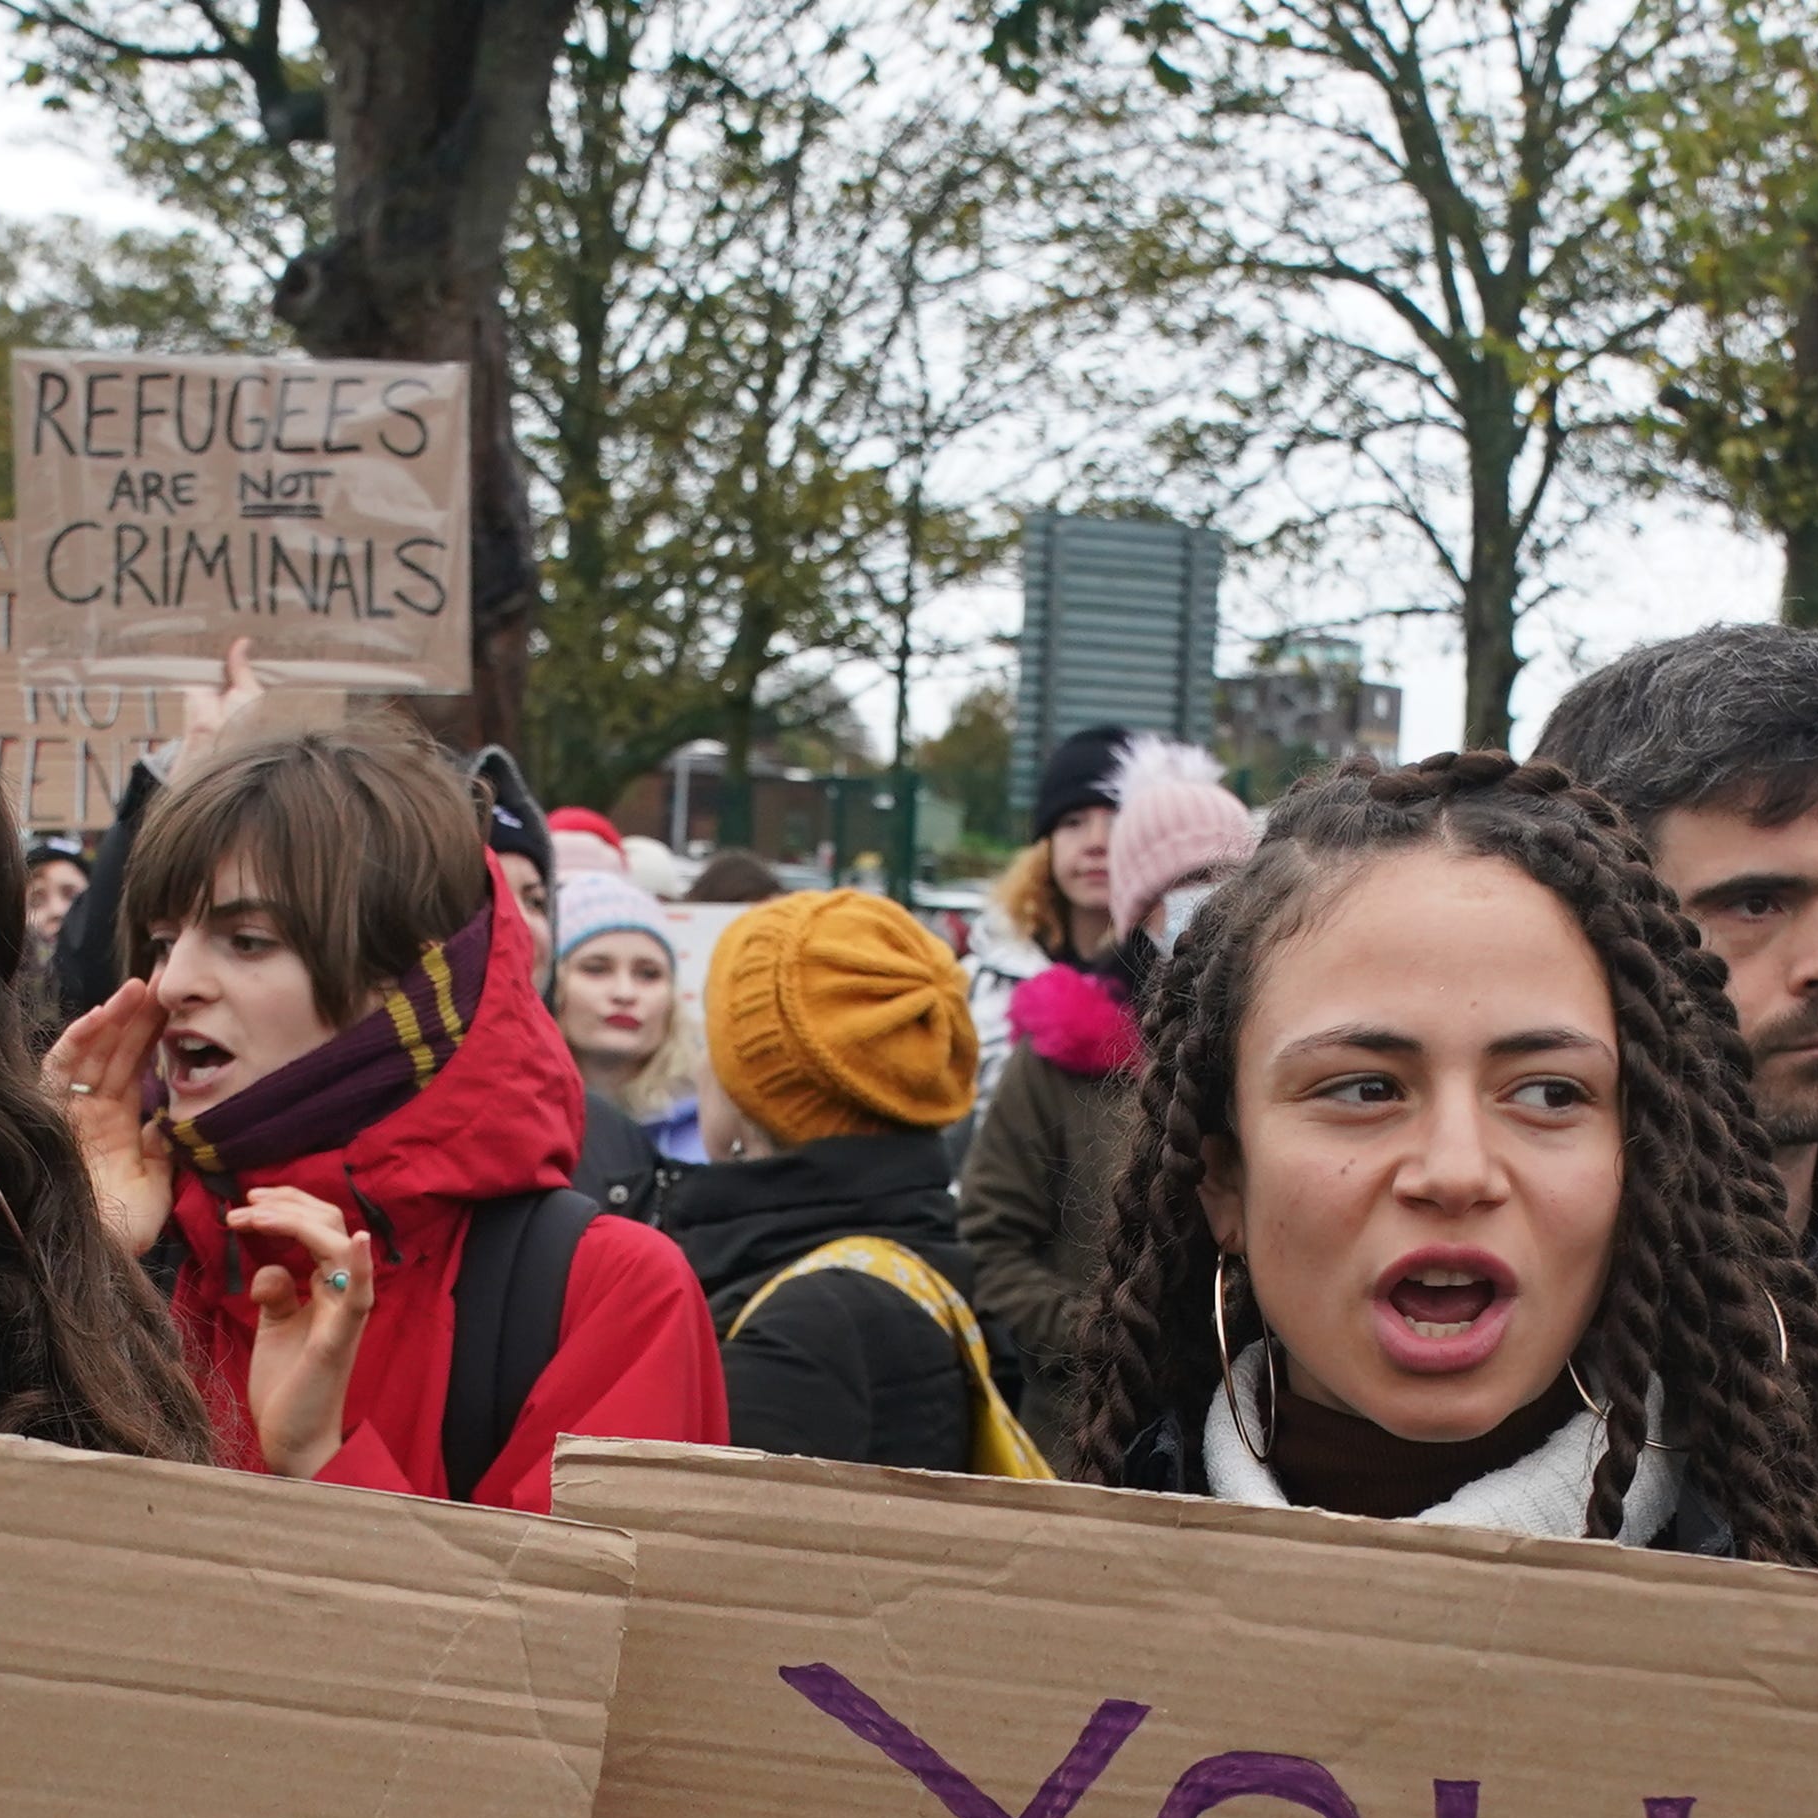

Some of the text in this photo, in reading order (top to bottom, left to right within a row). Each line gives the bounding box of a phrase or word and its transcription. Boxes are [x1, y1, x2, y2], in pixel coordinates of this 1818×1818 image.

[34, 371, 433, 459] REFUGEES
[108, 468, 335, 514] ARE NOT
[46, 521, 448, 621] CRIMINALS
